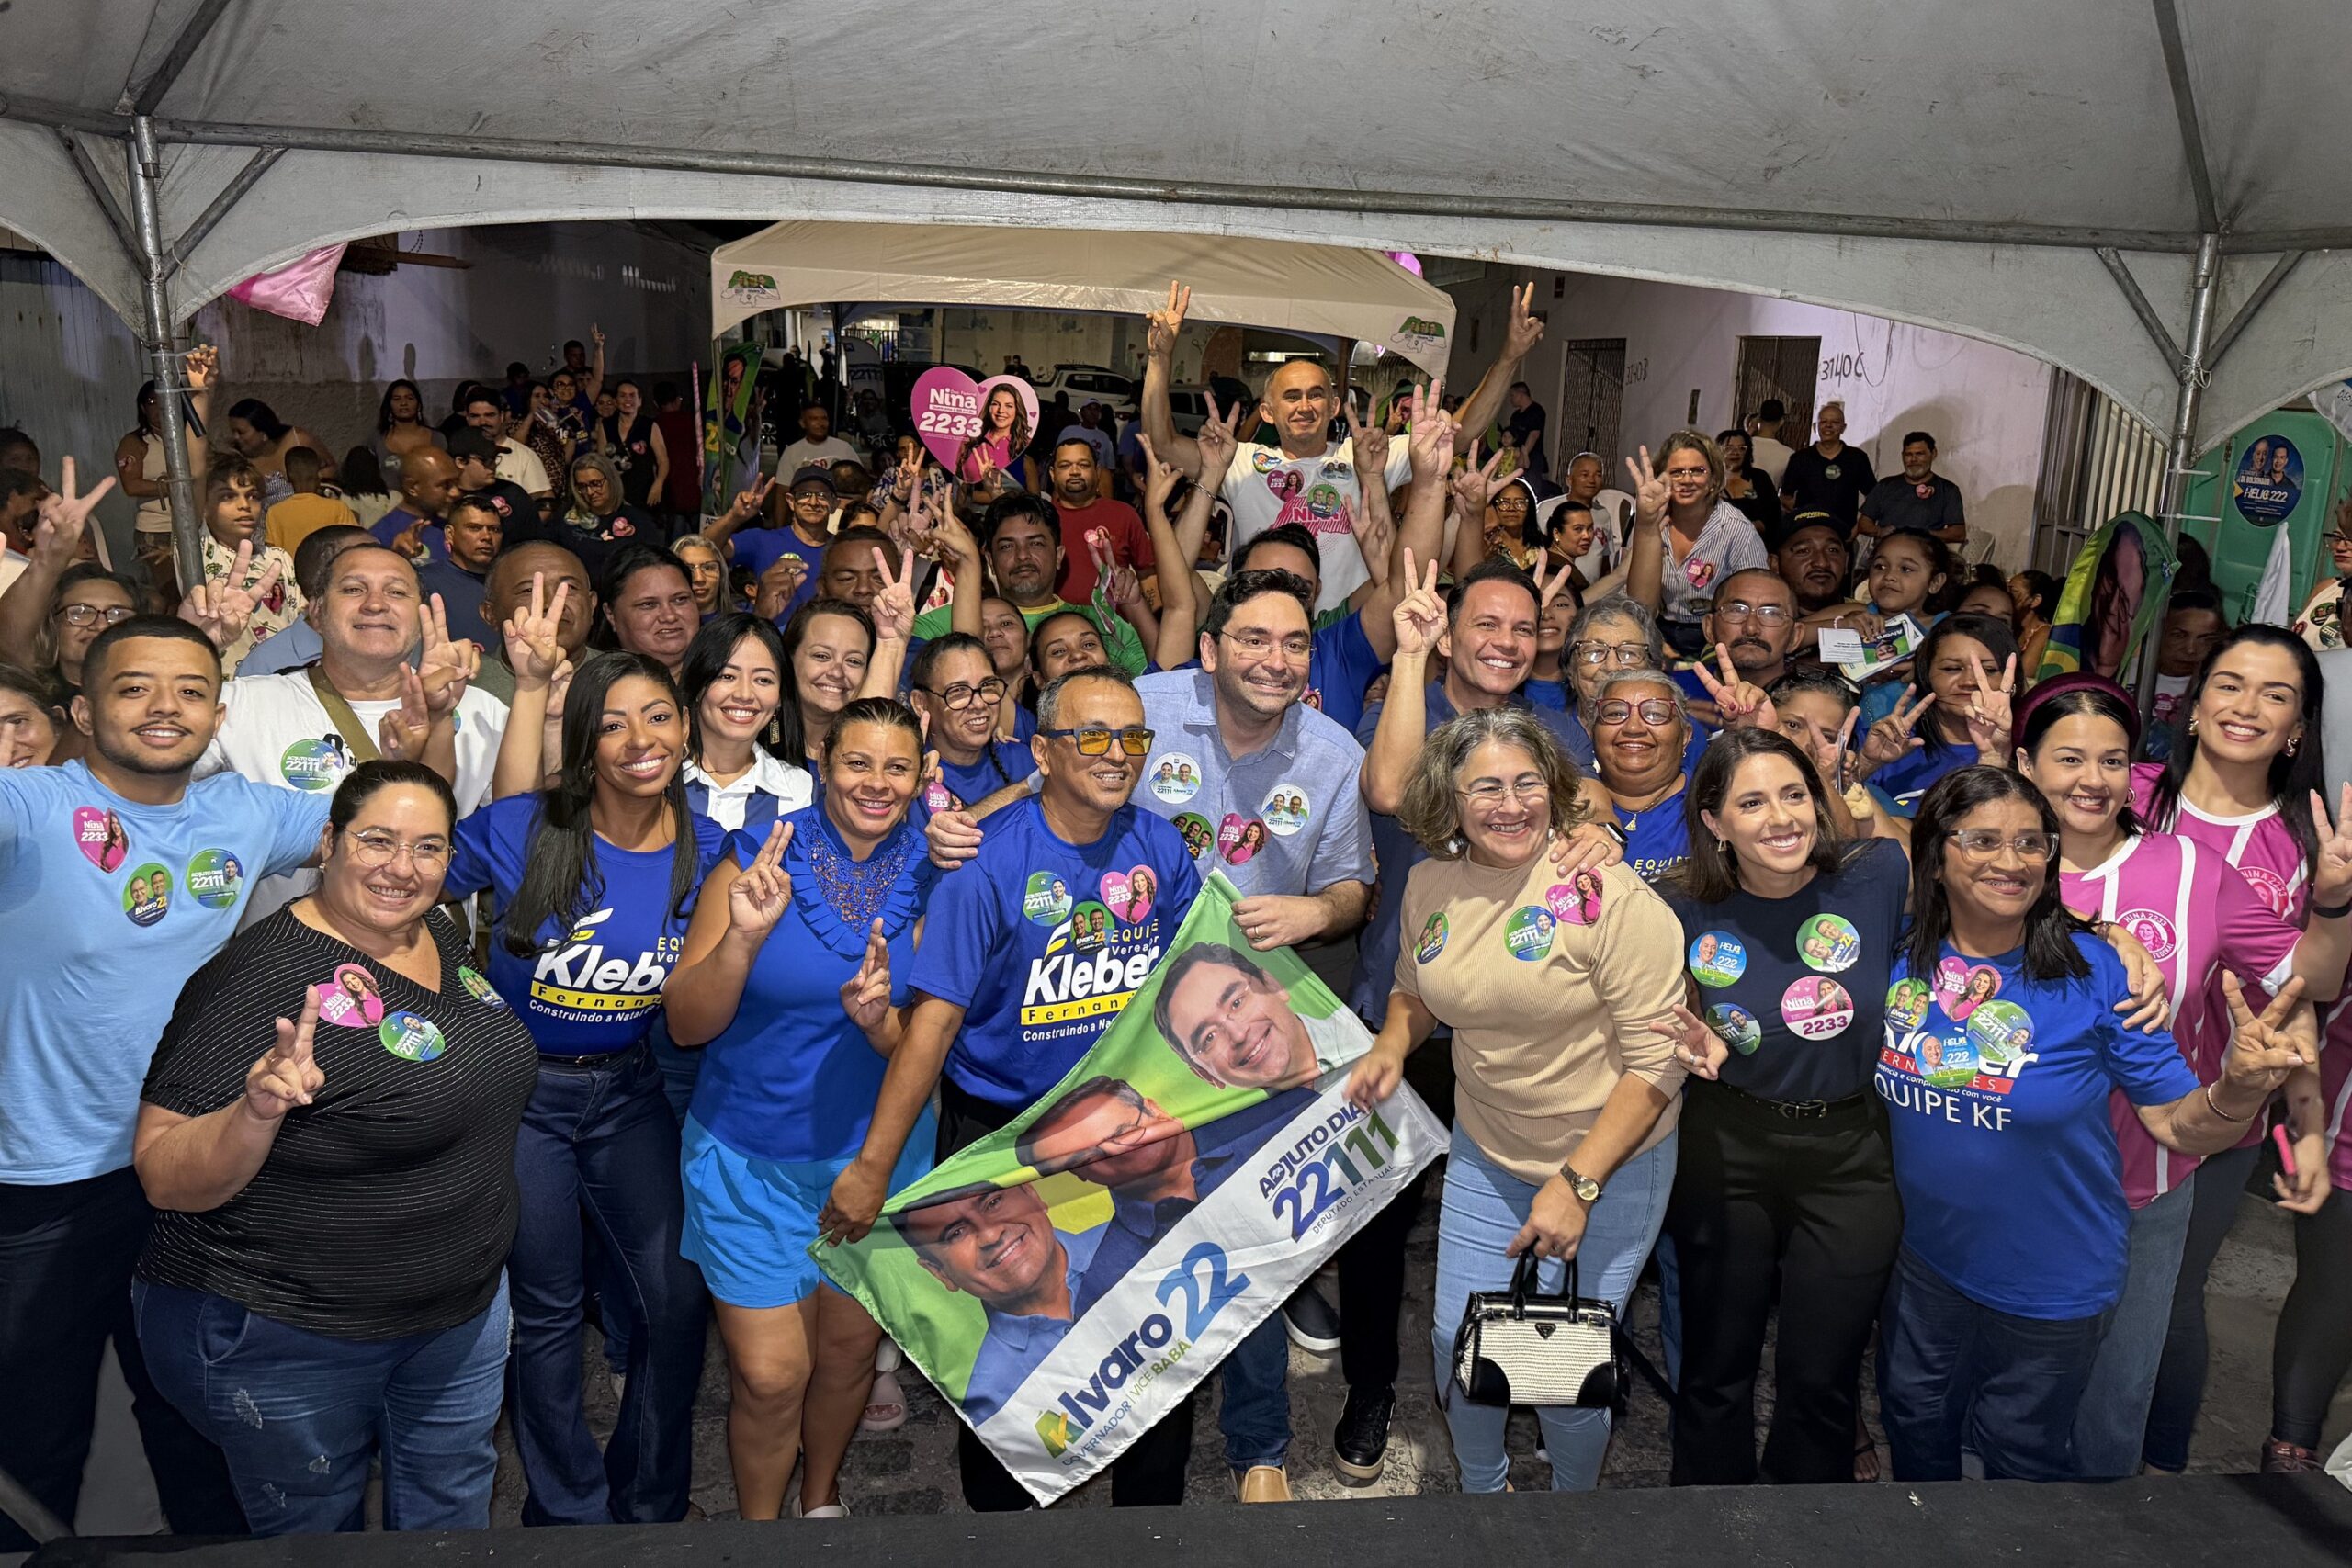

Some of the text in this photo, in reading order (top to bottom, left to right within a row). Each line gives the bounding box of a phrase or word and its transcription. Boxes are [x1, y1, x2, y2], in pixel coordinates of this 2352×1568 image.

[1821, 353, 1852, 388] 3140
[929, 388, 977, 410] Nina
[919, 412, 983, 438] 2233
[2268, 491, 2288, 502] 222
[285, 761, 320, 772] 22111
[81, 832, 108, 841] 2233
[1219, 833, 1240, 842] 2233
[191, 874, 225, 889] 22111
[2240, 870, 2268, 880] NINA
[135, 901, 157, 915] Alvaro
[156, 896, 167, 908] 22
[1025, 896, 1054, 910] 22111
[1108, 893, 1132, 905] 2233
[2123, 912, 2167, 927] NINA 2233
[1509, 929, 1539, 947] 22111
[534, 939, 670, 993] Kleb
[1716, 956, 1737, 969] 222
[1023, 946, 1159, 1006] Kleber
[538, 986, 662, 1007] Fernan
[1029, 992, 1136, 1021] Fernan
[1786, 996, 1814, 1009] Nina
[330, 997, 356, 1021] 2233
[529, 1000, 602, 1022] Construindo
[605, 1013, 612, 1022] a
[1803, 1016, 1848, 1035] 2233
[1907, 1013, 1919, 1026] 22
[1974, 1012, 2008, 1042] 22111
[1023, 1021, 1088, 1042] Construindo
[1091, 1023, 1096, 1032] a
[1944, 1037, 1966, 1046] HELIO
[399, 1032, 423, 1055] 22111
[1948, 1052, 1970, 1064] 222
[1874, 1073, 2012, 1131] QUIPE KF
[1962, 1089, 1979, 1099] com
[1982, 1093, 2002, 1103] você
[1259, 1101, 1367, 1199] ADJUTO DIA
[1272, 1110, 1400, 1244] 22111
[1312, 1196, 1353, 1235] DEPUTADO
[1354, 1165, 1395, 1197] ESTADUAL
[1155, 1241, 1251, 1344] 22
[1062, 1401, 1132, 1467] GOVERNADOR
[1131, 1371, 1154, 1398] VICE
